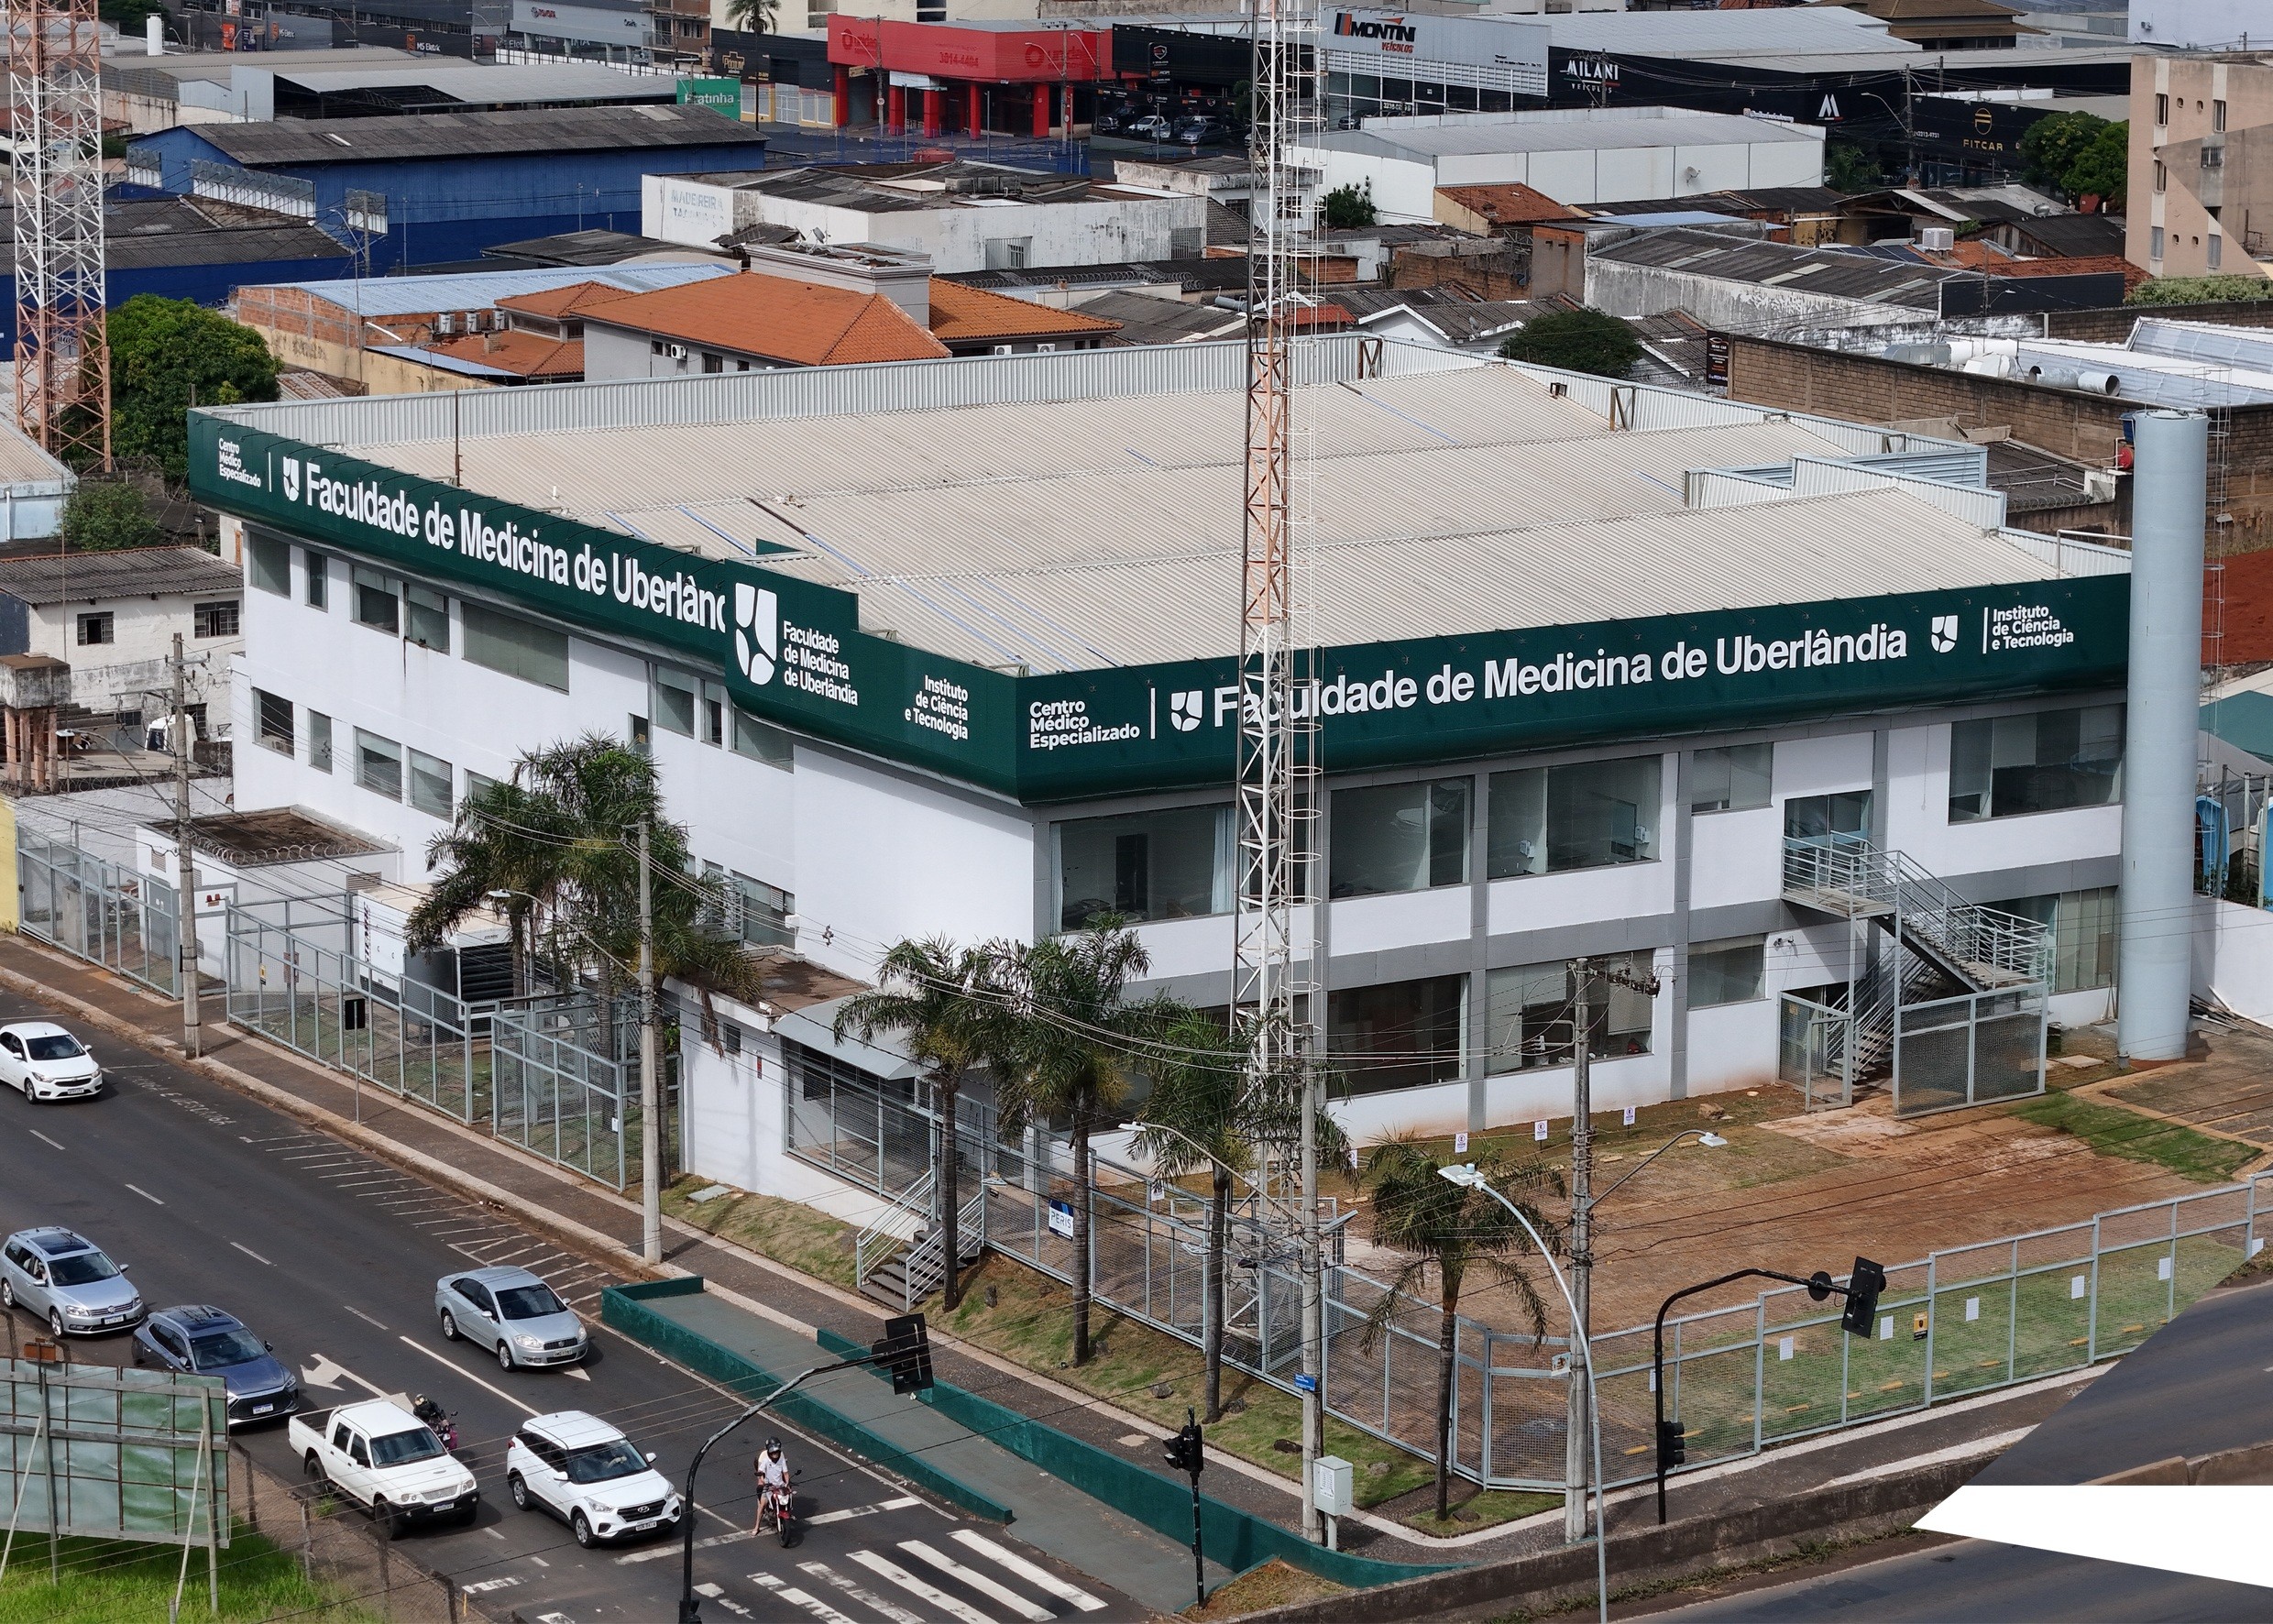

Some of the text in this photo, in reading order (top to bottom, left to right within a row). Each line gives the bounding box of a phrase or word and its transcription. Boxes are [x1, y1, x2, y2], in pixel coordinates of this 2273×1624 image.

[1566, 60, 1619, 80] MILANI
[1963, 139, 2003, 151] FITCAR
[219, 438, 240, 455] Centro
[219, 449, 242, 469] Médico
[219, 464, 261, 488] Especializado
[306, 462, 420, 538] Faculdade
[425, 501, 455, 550] de
[461, 509, 569, 587] Medicina
[574, 543, 607, 596] de
[1993, 604, 2049, 622] Instituto
[783, 620, 840, 655] Faculdade
[1992, 616, 2060, 637] de Ciência
[1992, 628, 2074, 650] e Tecnologia
[784, 644, 849, 680] de Medicina
[784, 666, 858, 707] de Uberlândia
[1214, 623, 1907, 727] Faculdade de Medicina de Uberlândia
[925, 675, 968, 702] Instituto
[915, 691, 968, 721] de Ciência
[1029, 698, 1086, 718] Centro
[905, 708, 968, 741] e Tecnologia
[1030, 713, 1090, 733] Médico
[1030, 723, 1140, 751] Especializado
[1051, 1211, 1071, 1229] PERIS
